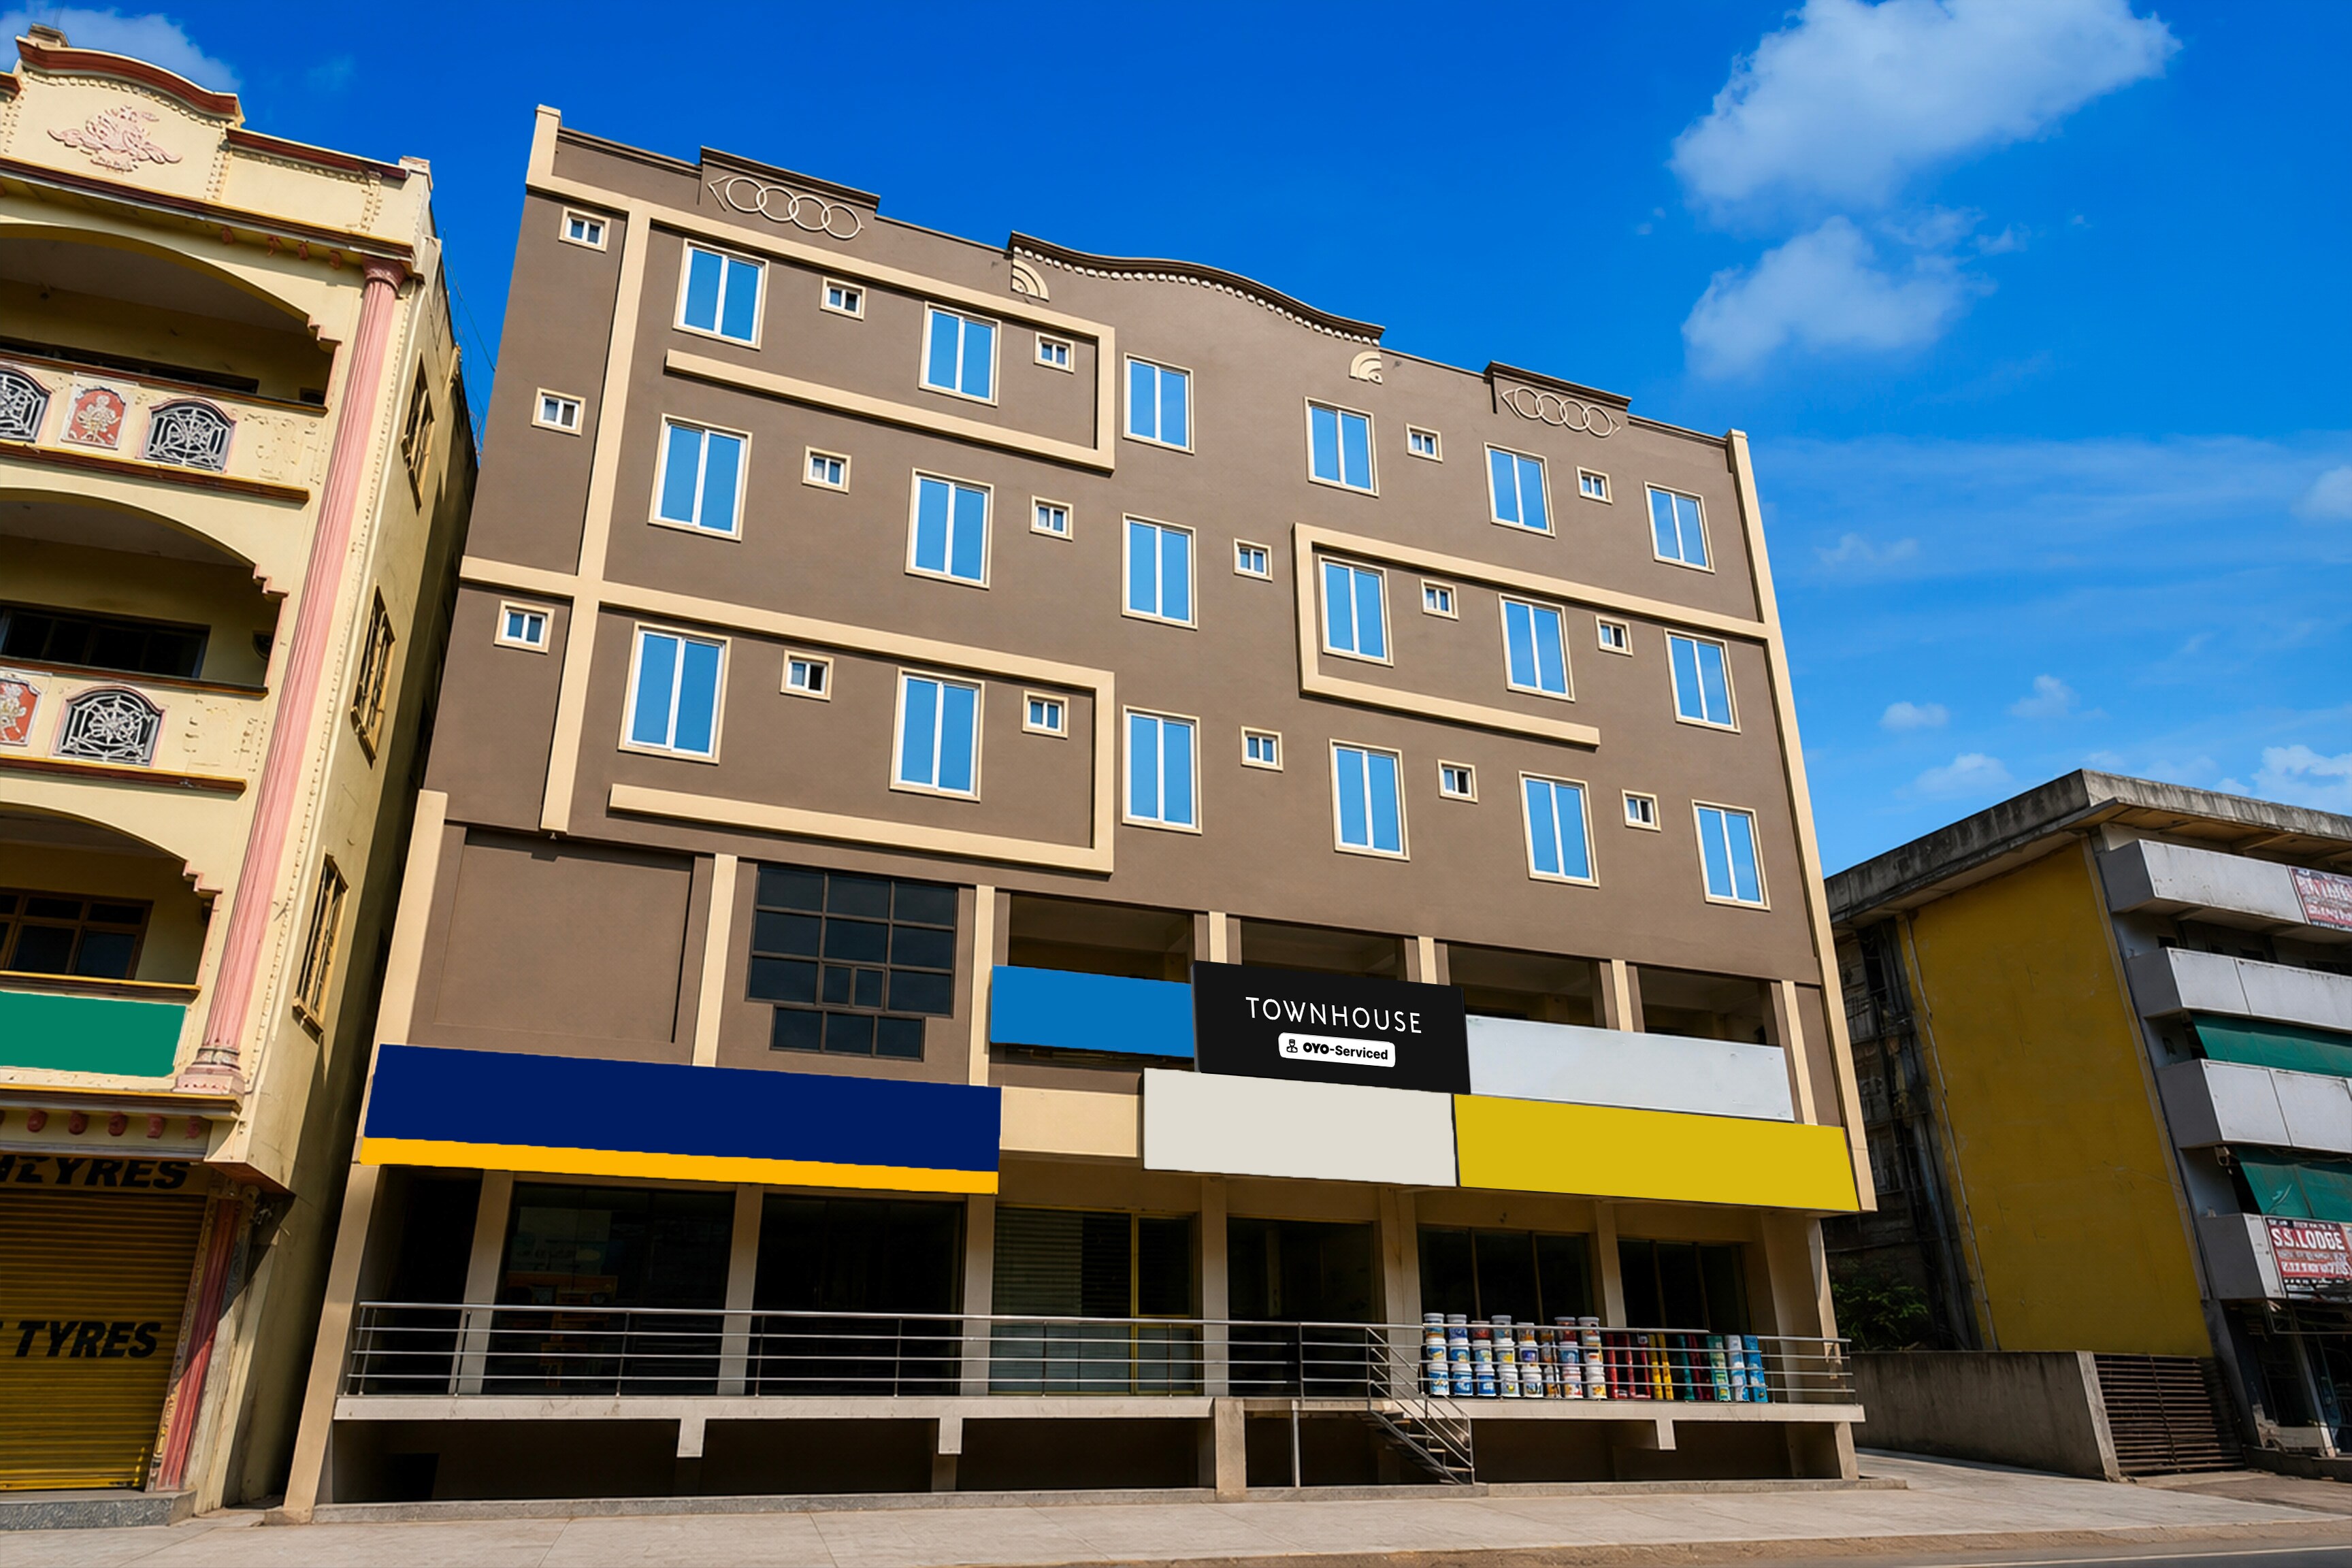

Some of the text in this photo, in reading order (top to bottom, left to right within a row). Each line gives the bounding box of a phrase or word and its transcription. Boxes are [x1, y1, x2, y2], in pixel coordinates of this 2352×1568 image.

[1246, 997, 1421, 1034] TOWNHOUSE
[1303, 1042, 1388, 1060] OYO-Serviced
[16, 1321, 162, 1357] TYRES
